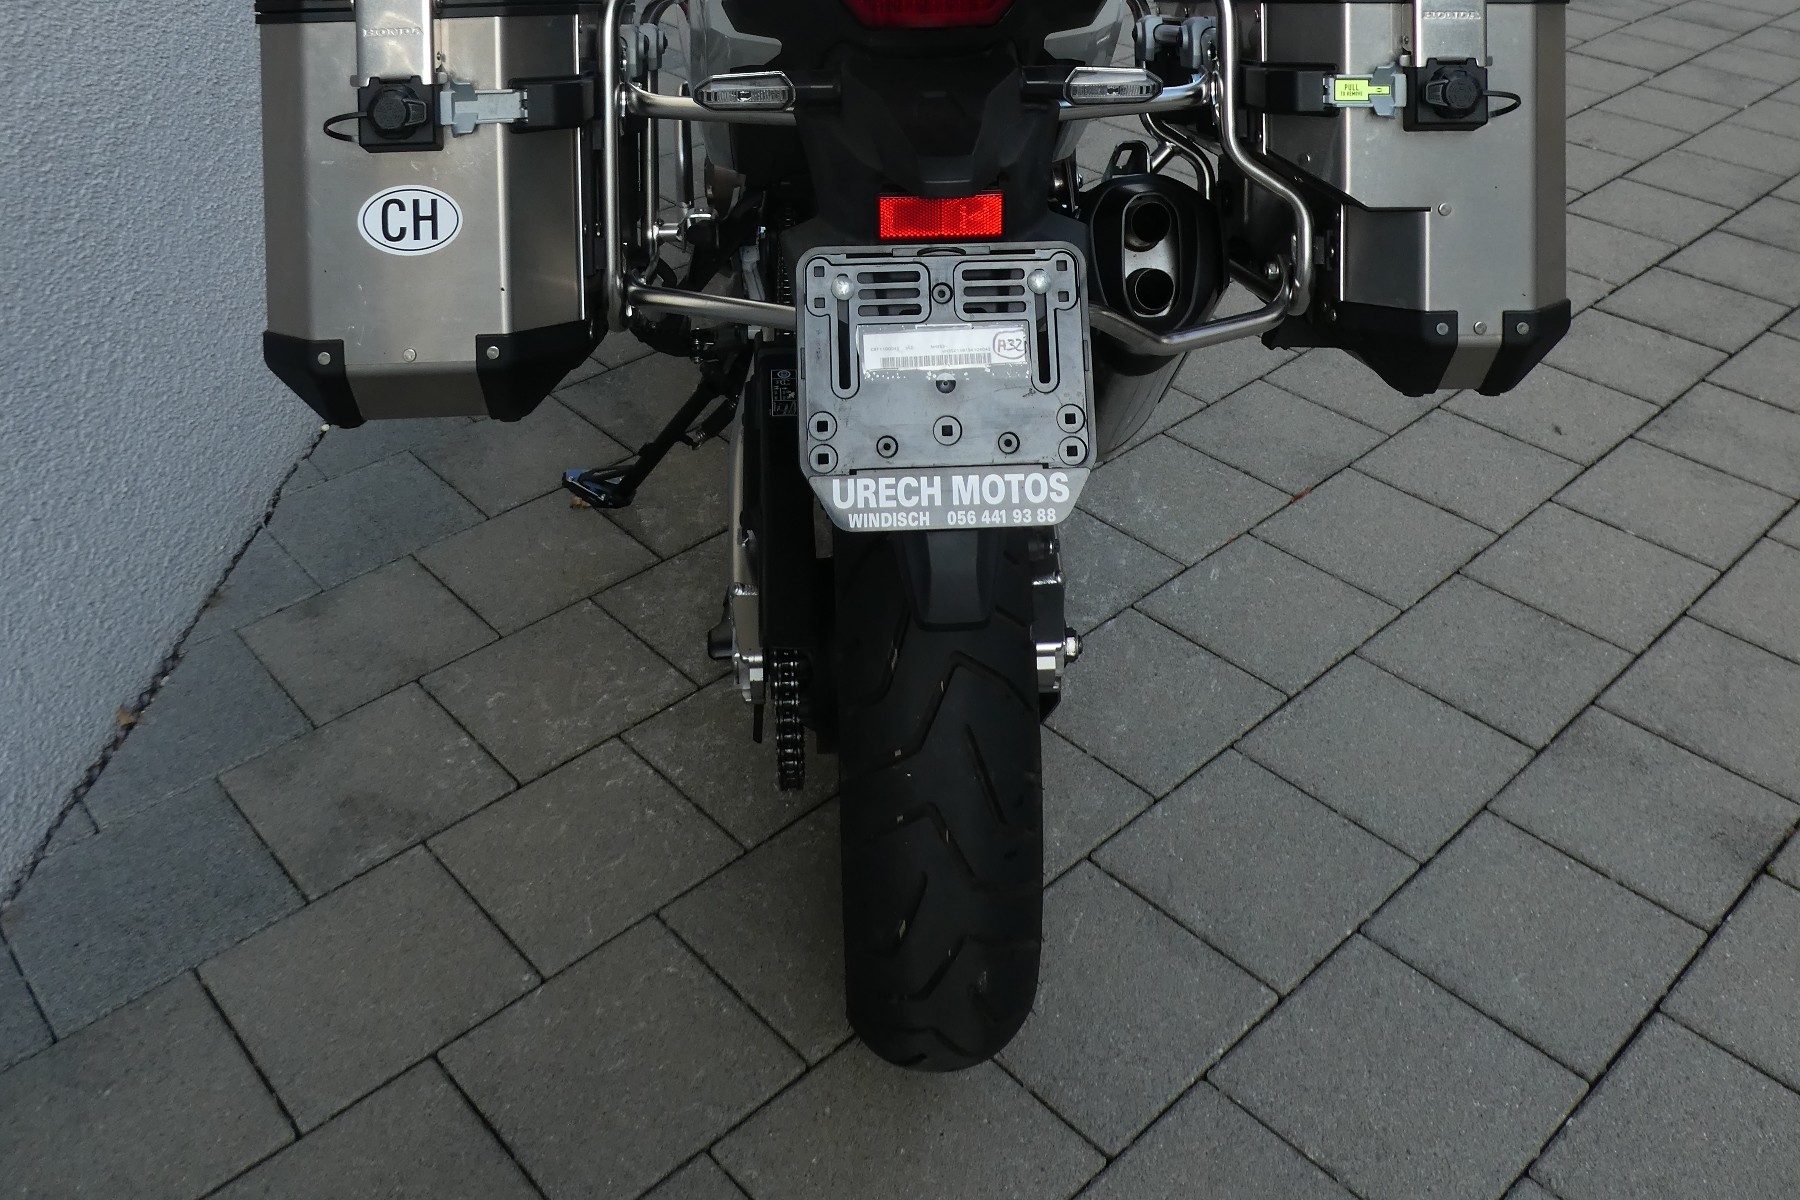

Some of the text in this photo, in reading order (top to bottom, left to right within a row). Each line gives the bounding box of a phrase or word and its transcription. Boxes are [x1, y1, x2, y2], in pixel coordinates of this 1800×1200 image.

[1422, 10, 1481, 20] HONDA
[362, 27, 423, 37] HONDA
[381, 198, 439, 242] CH
[997, 338, 1024, 353] A32
[832, 472, 1070, 509] URECH MOTOS
[848, 507, 1057, 528] WINDISCH 056 441 93 88
